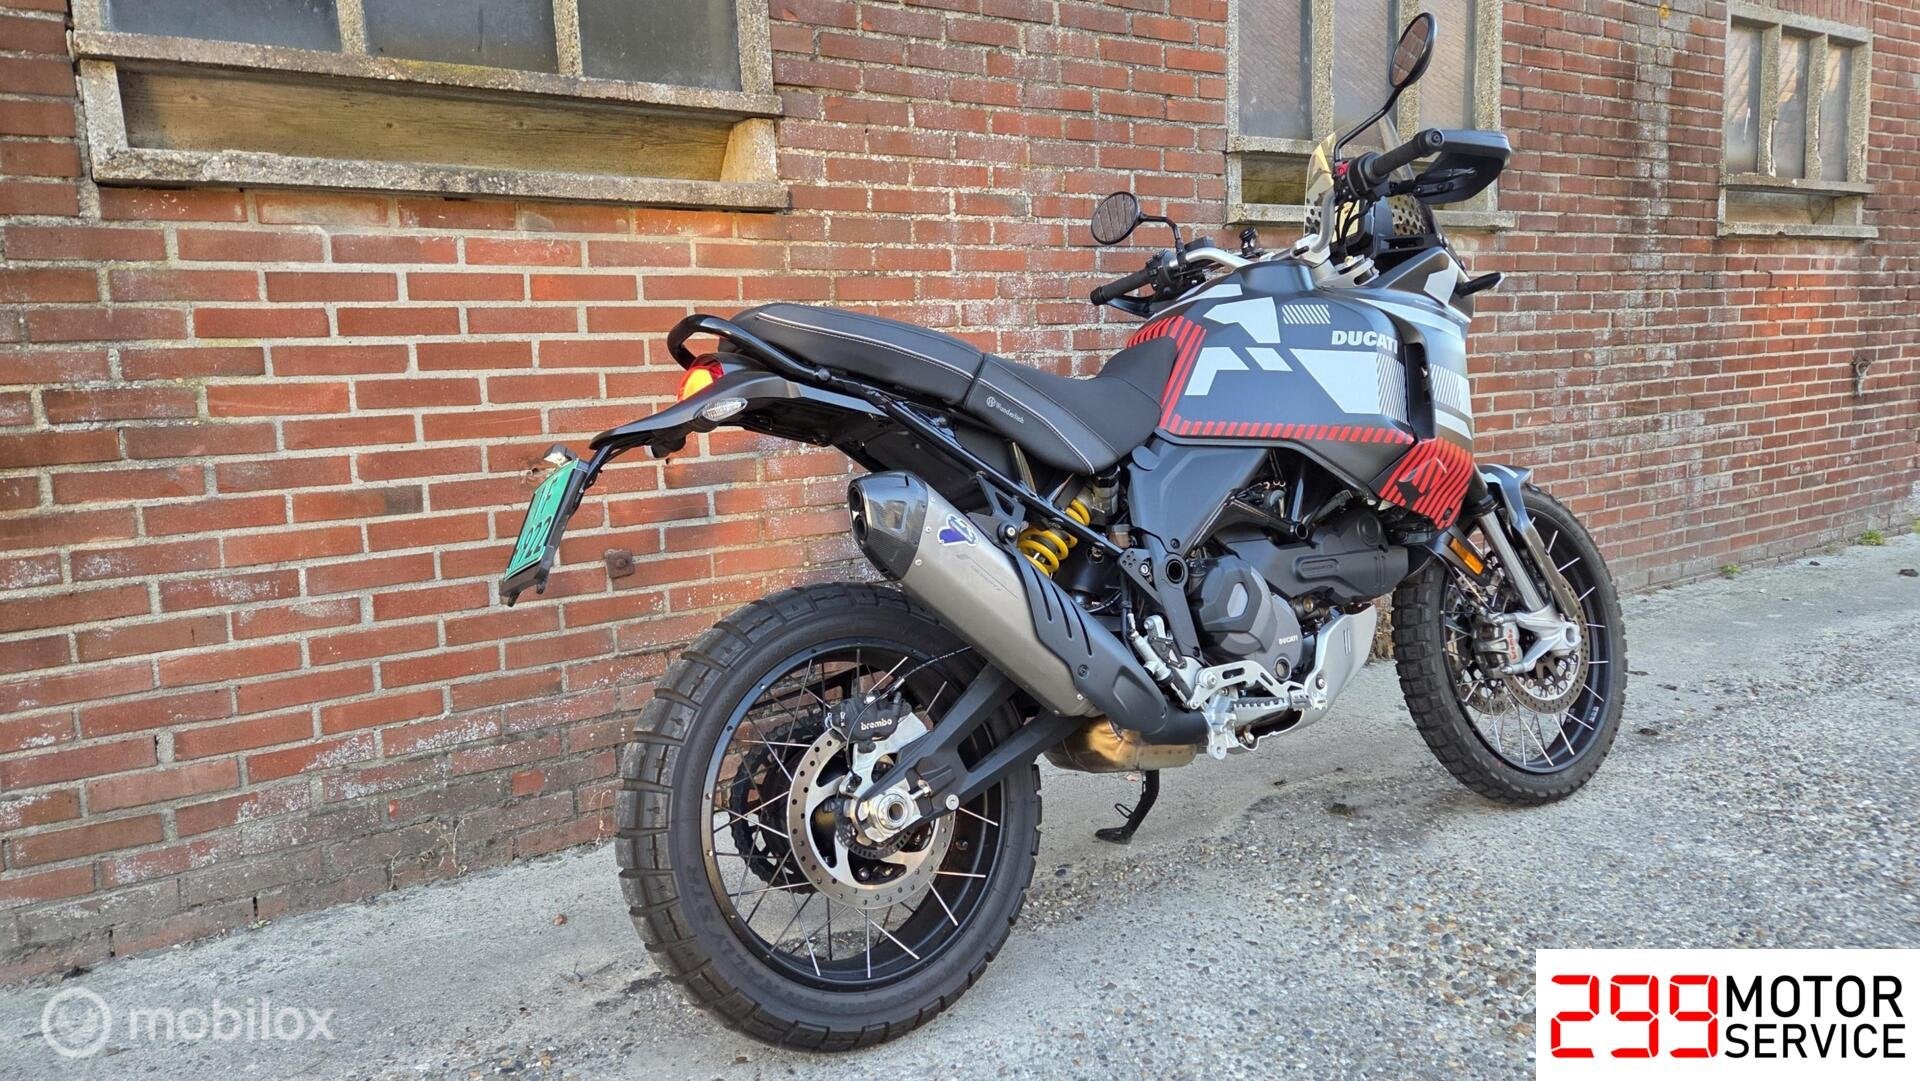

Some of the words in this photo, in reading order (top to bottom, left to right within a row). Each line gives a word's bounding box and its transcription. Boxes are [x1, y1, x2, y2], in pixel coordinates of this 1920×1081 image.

[1331, 330, 1398, 354] DUCATI
[1278, 634, 1298, 645] DUCATI
[860, 718, 893, 731] brembo
